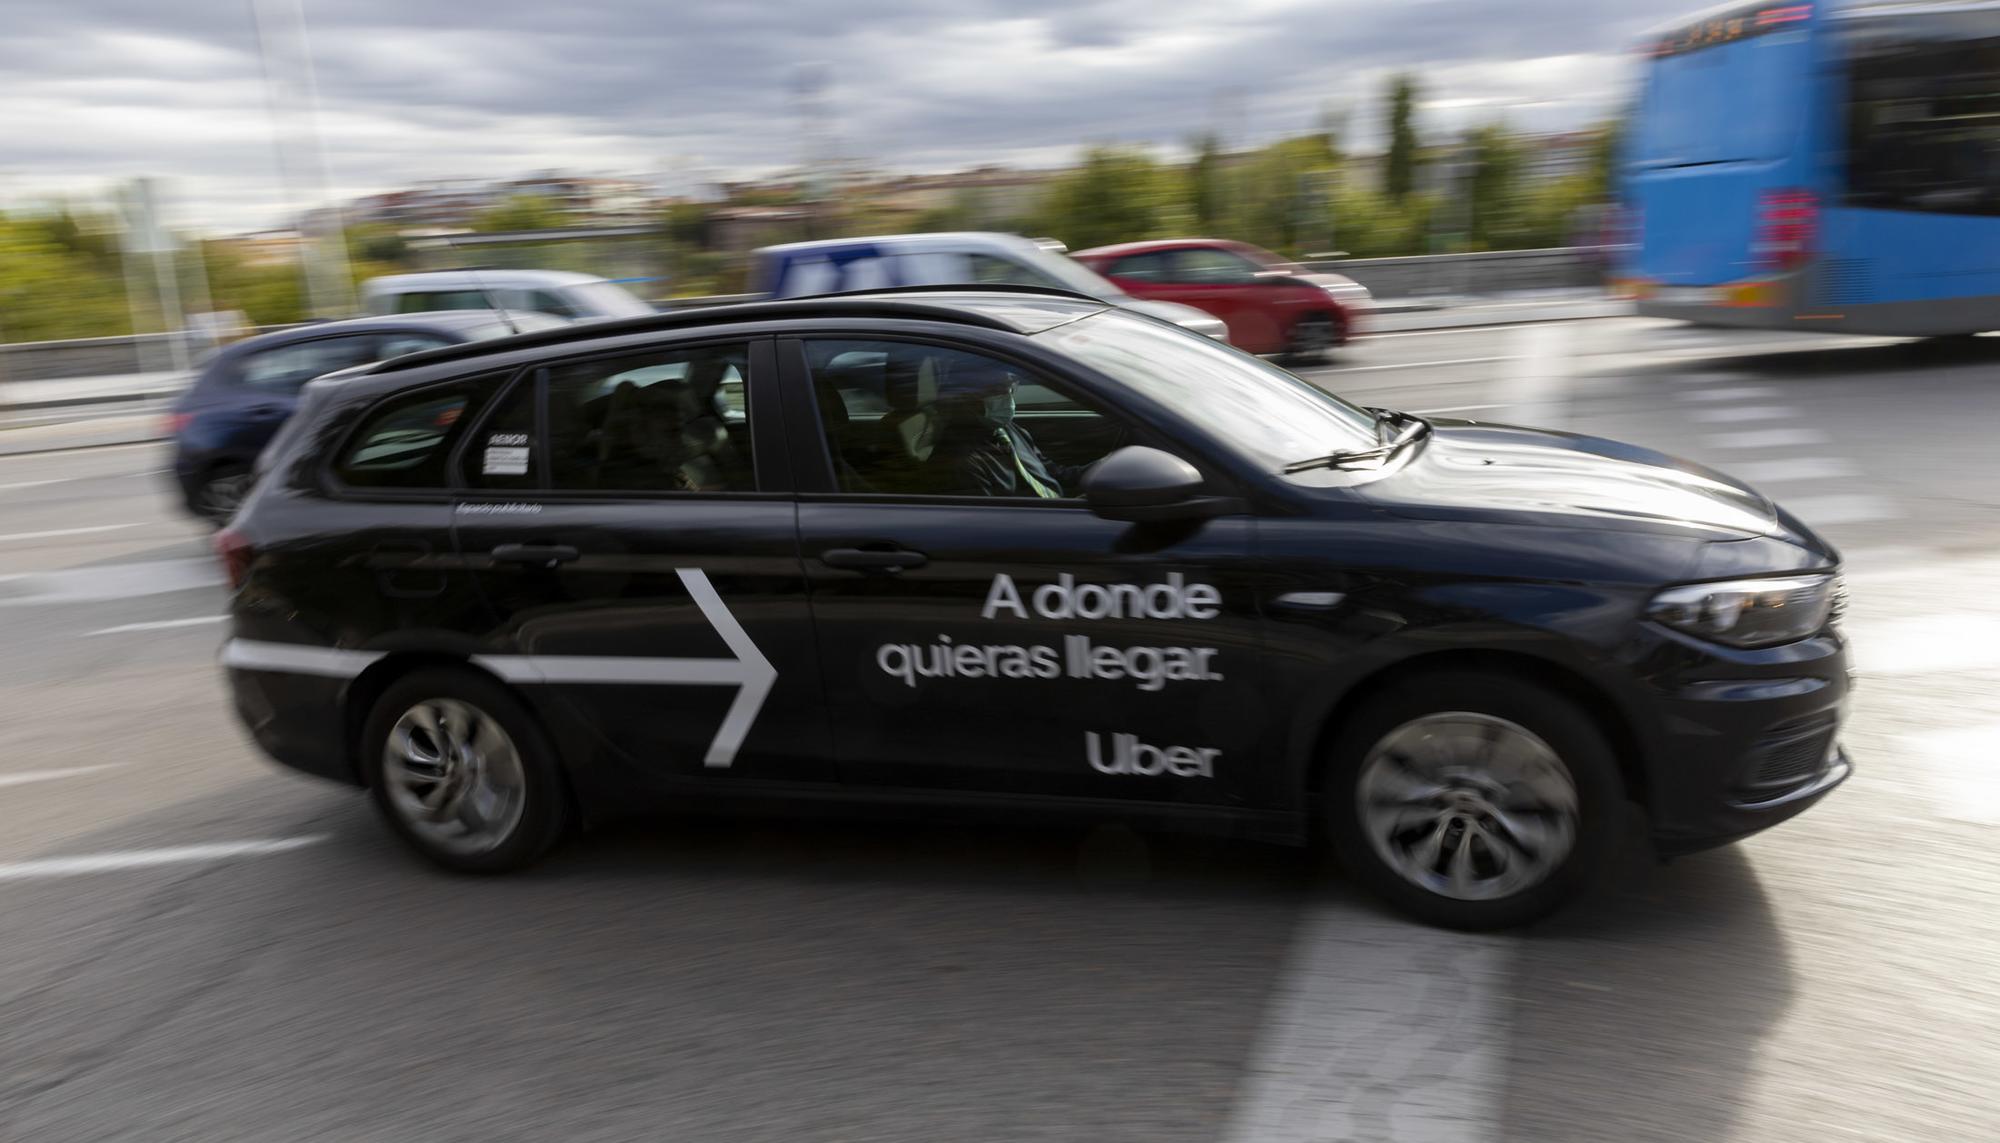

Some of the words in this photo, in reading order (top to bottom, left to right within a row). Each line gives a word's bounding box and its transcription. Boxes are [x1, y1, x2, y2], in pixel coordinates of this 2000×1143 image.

[982, 573, 1029, 619] A
[1033, 572, 1222, 620] donde
[877, 634, 1061, 687] quieras
[1064, 634, 1224, 691] llegar.
[1085, 731, 1222, 778] Uber
